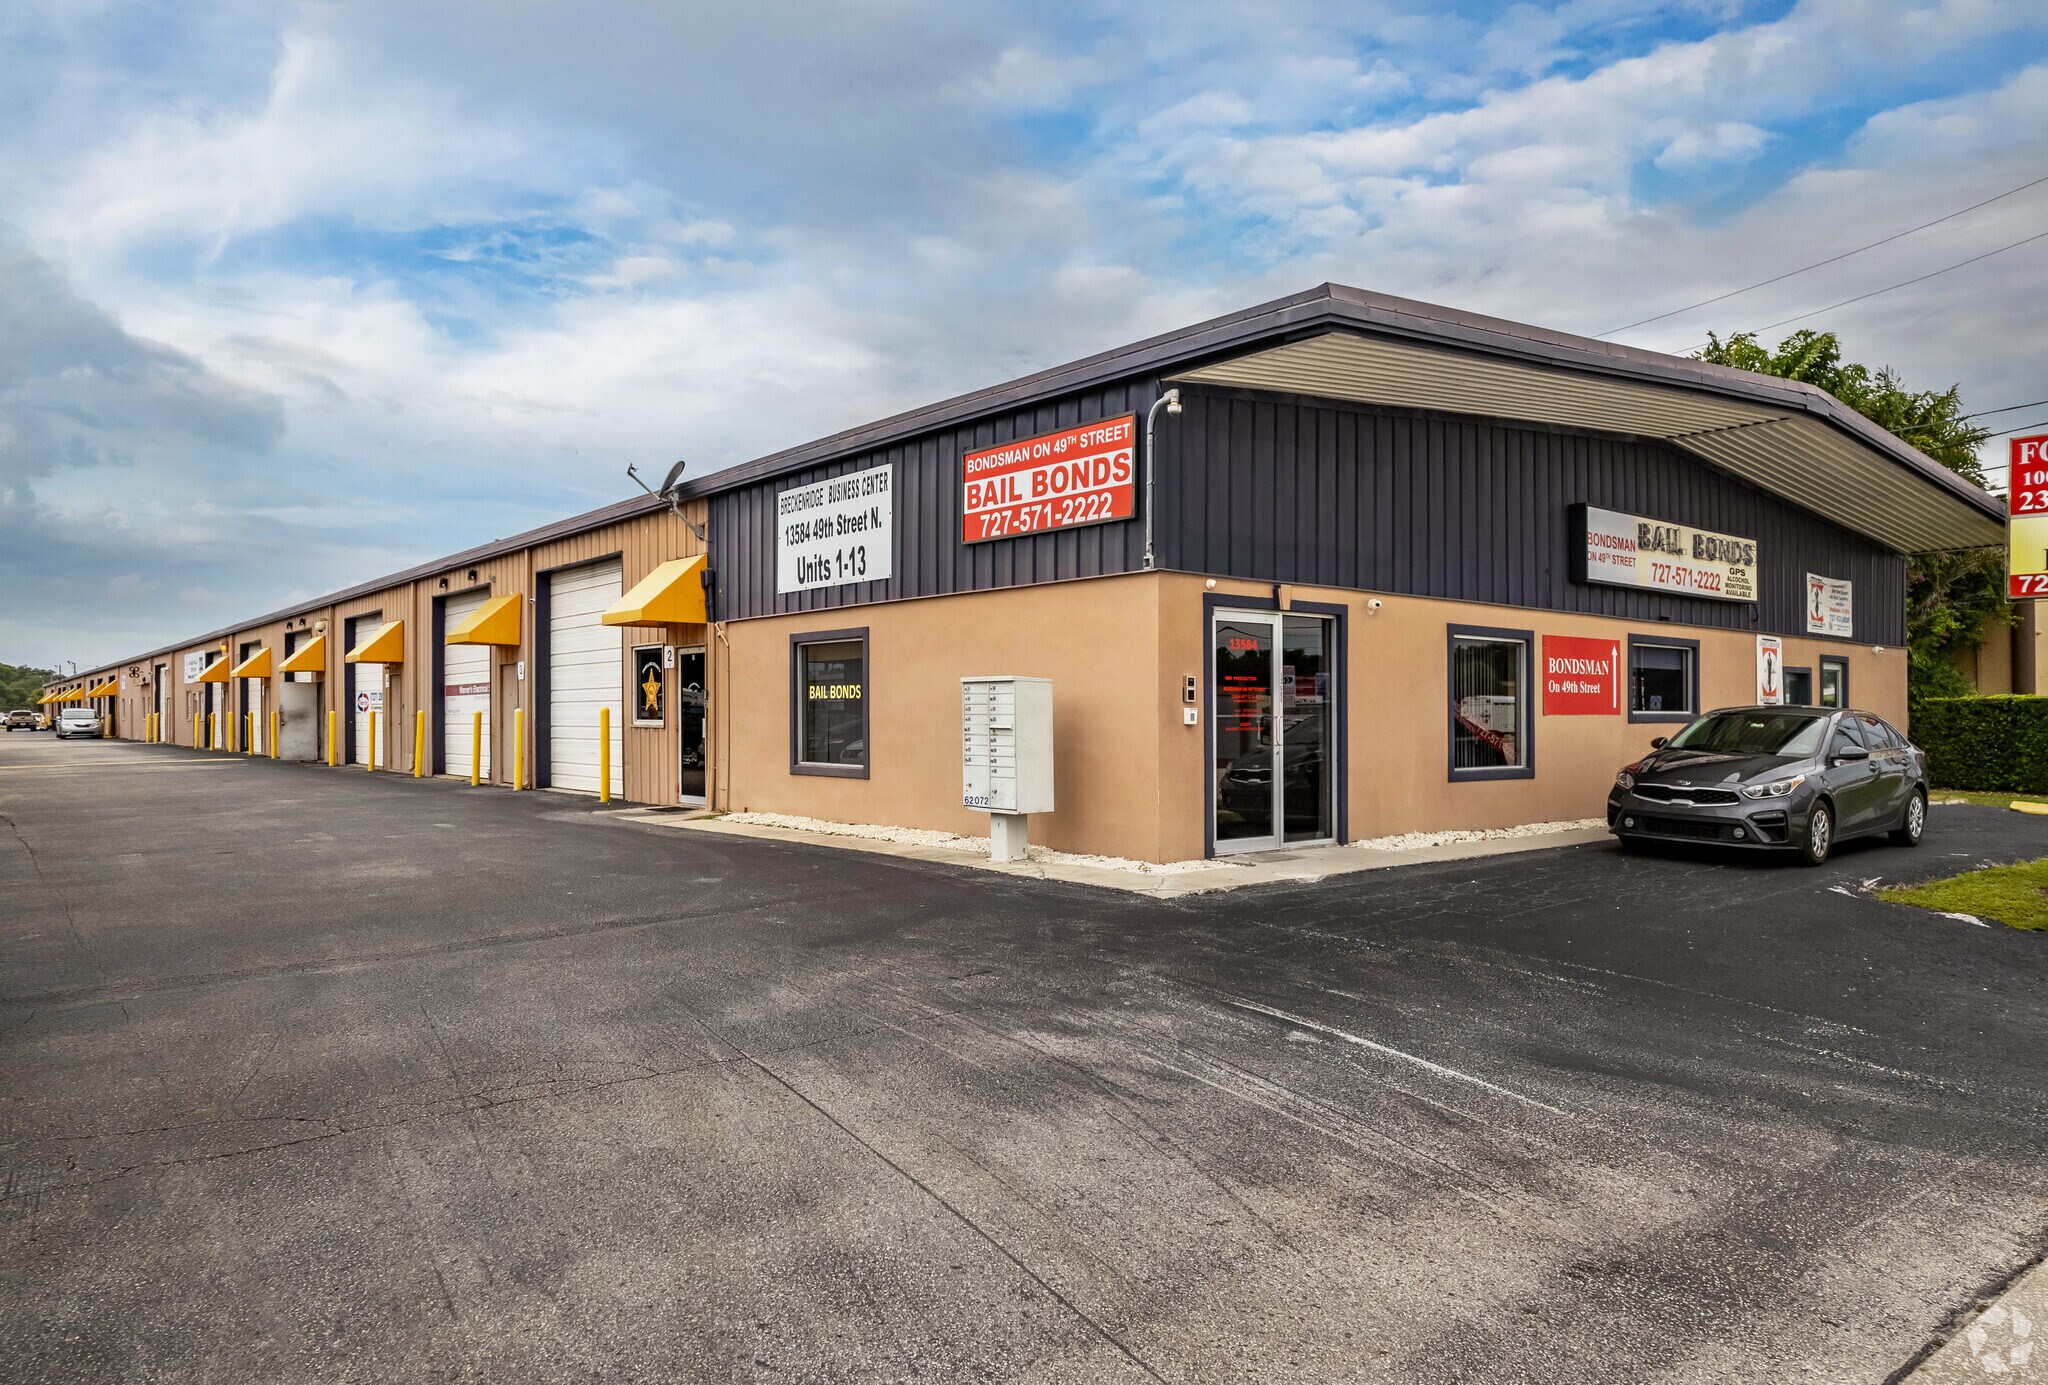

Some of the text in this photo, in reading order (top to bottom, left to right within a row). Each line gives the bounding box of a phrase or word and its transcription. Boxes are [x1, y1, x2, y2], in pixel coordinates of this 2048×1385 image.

[967, 423, 1131, 473] BONDSMAN ON 49TH STREET
[967, 452, 1131, 510] BAIL BONDS
[780, 471, 889, 515] BRECKENRIDGE BUSINESS CENTER
[980, 492, 1113, 538] 727-571-2222
[785, 506, 882, 546] 13584 49th Street N.
[1587, 532, 1636, 552] BONDSMAN
[1638, 523, 1757, 567] BAIL BONDS
[797, 545, 866, 585] Units 1-13
[1587, 551, 1597, 561] ON
[1612, 554, 1636, 567] STREET
[1652, 562, 1721, 591] 727-571-2222
[1729, 567, 1746, 576] GPS
[1725, 582, 1752, 591] MONITORING
[1726, 589, 1751, 598] AVAILABLE
[667, 650, 672, 661] 2
[1549, 657, 1609, 675] BONDSMAN
[810, 685, 861, 699] BAIL BONDS
[1548, 680, 1600, 693] On 49th Street
[964, 795, 989, 805] 62072
